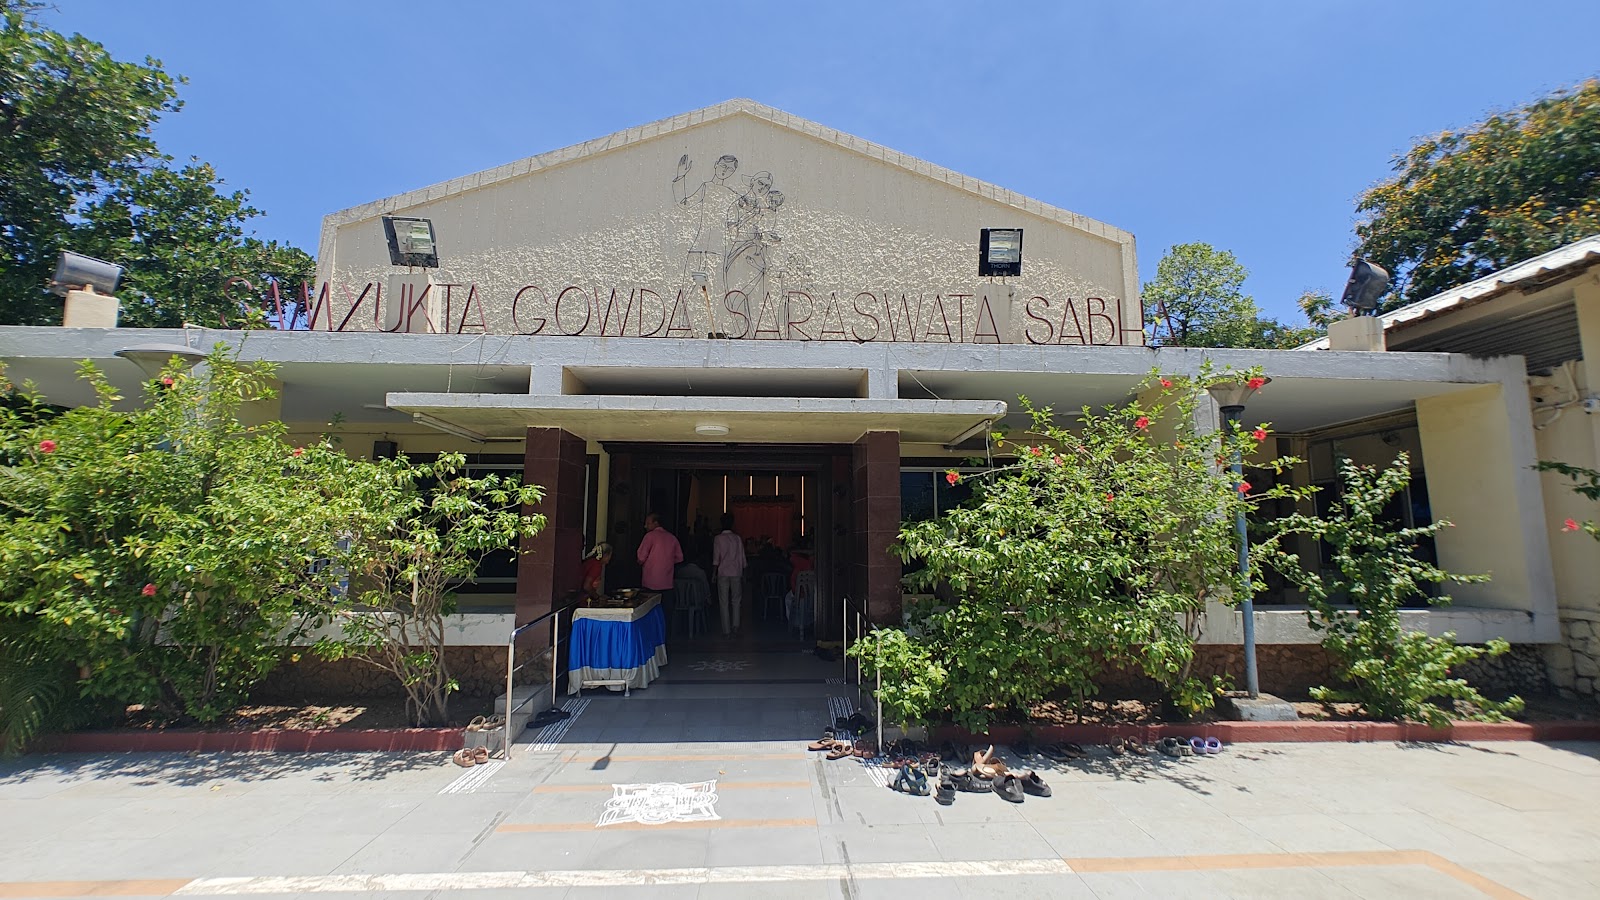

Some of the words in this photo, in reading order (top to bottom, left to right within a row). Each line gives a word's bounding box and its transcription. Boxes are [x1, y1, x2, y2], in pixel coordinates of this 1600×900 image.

[221, 276, 488, 334] SAMYUKTA
[512, 285, 694, 338] GOWDA
[721, 289, 1002, 343] SARASWATA
[1025, 294, 1179, 346] SABHA
